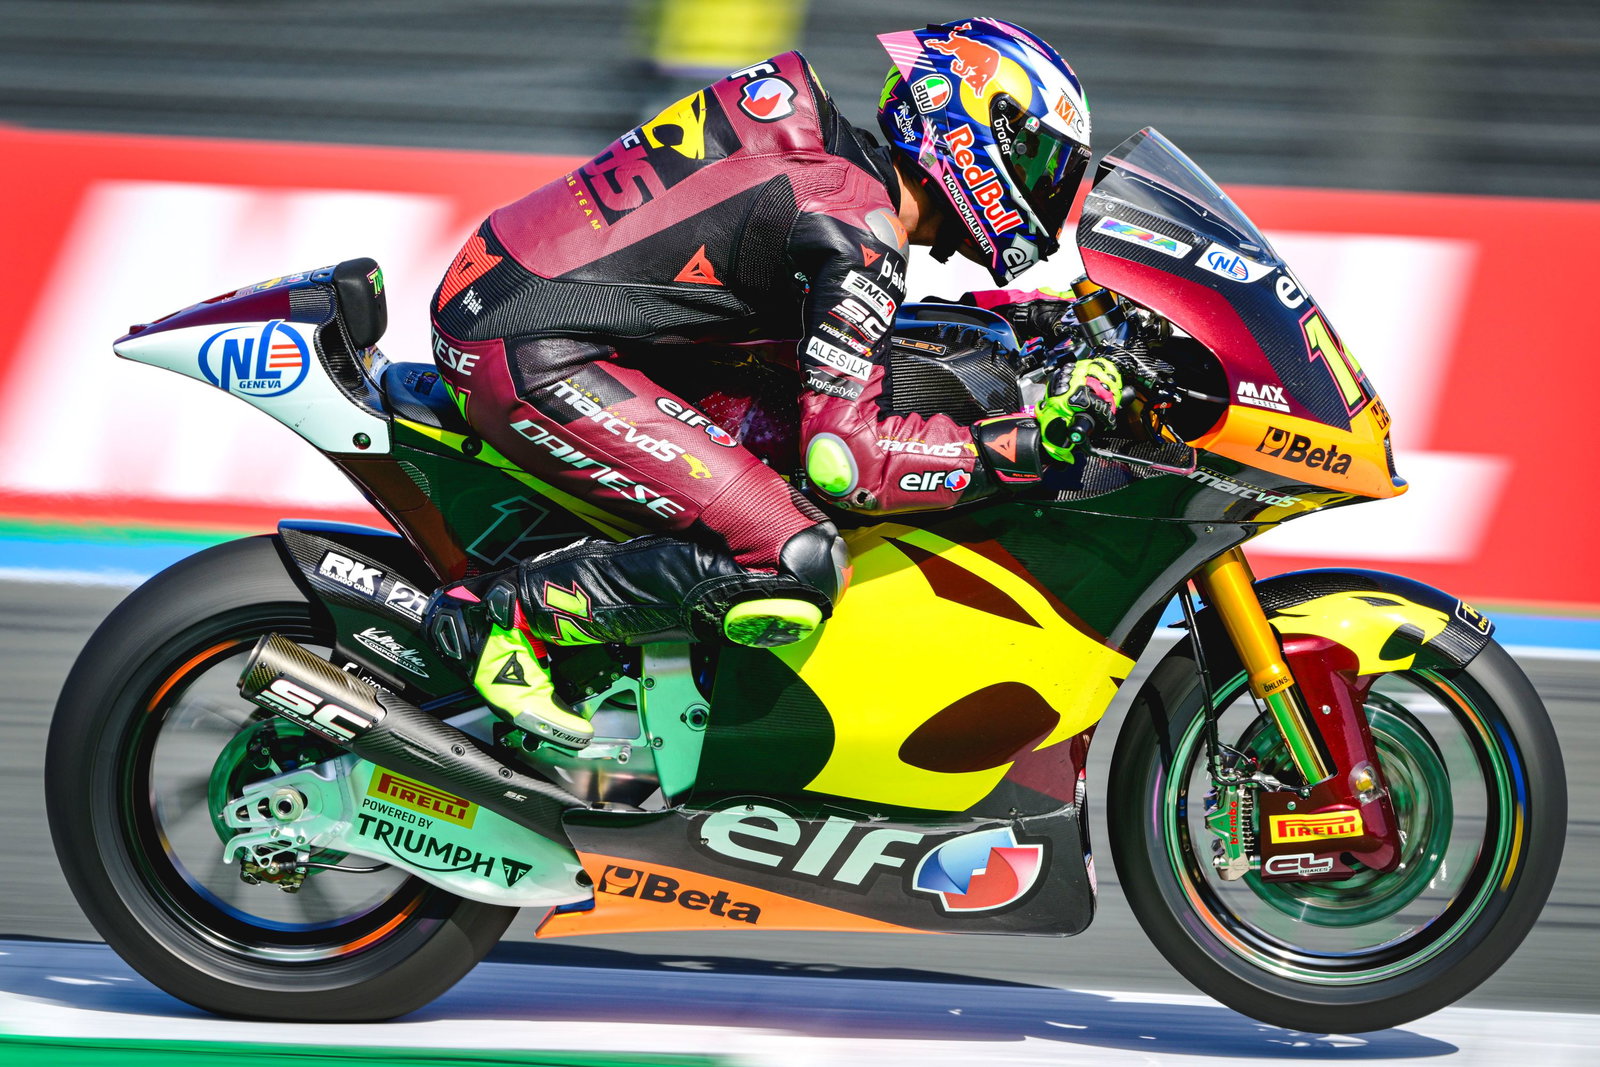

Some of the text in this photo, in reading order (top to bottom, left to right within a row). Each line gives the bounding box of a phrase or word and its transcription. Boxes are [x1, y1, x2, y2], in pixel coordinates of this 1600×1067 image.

[993, 117, 1012, 156] brofer
[574, 189, 602, 230] TEAM
[942, 174, 994, 255] MONDOMALDIVE.IT
[238, 379, 282, 389] GENEVA
[1236, 381, 1288, 404] MAX
[656, 397, 711, 428] elf
[509, 419, 686, 519] DAINESE
[1282, 433, 1352, 476] Beta
[900, 472, 946, 491] elf
[320, 551, 383, 592] RK
[353, 582, 374, 597] CHAIN
[254, 694, 350, 742] PROJECT
[260, 679, 371, 740] SC
[362, 798, 434, 830] POWERED BY
[377, 772, 471, 821] PIRELLI
[699, 803, 925, 885] elf
[1228, 801, 1239, 845] brembo
[1277, 815, 1356, 838] PIRELLI
[357, 812, 496, 878] TRIUMPH
[639, 872, 762, 925] Beta
